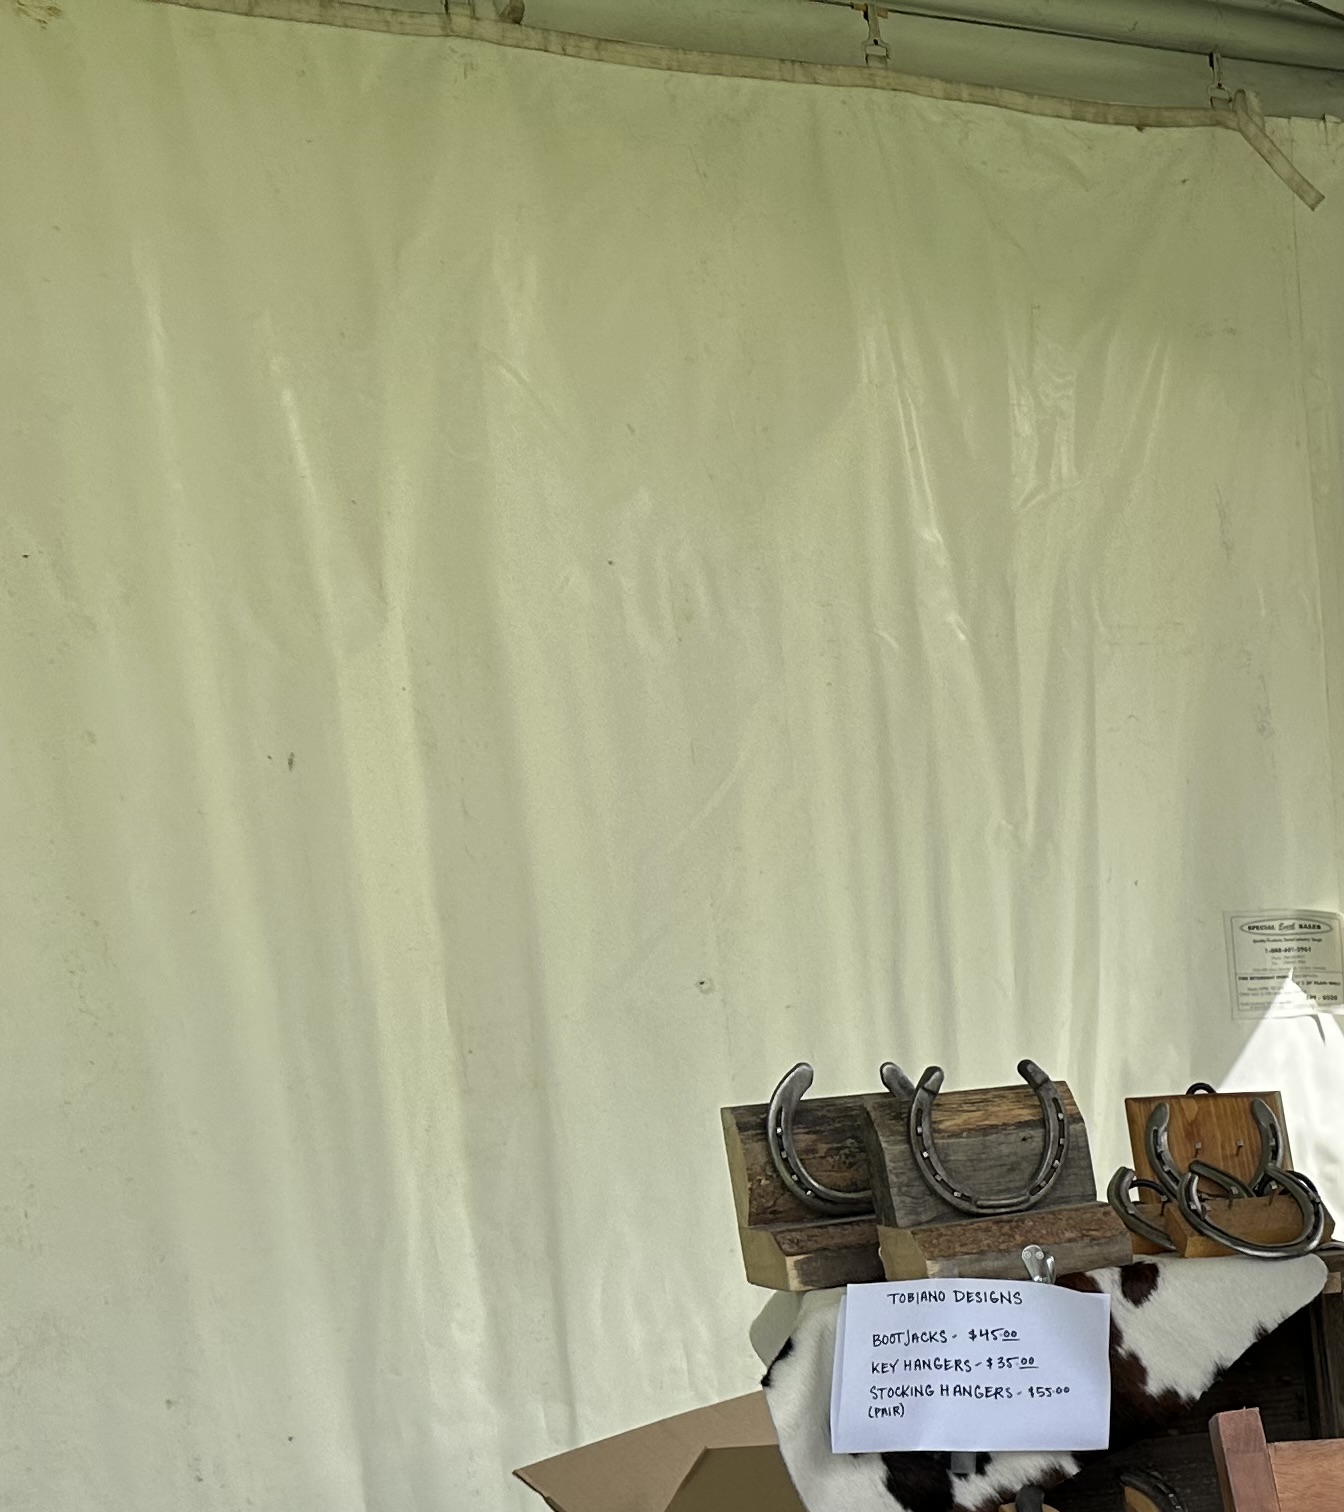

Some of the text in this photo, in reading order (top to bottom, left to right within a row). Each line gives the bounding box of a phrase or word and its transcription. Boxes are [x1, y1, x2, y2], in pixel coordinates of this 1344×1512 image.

[887, 1289, 1023, 1305] TOBIANO DESIGNS
[871, 1358, 900, 1375] KEY
[903, 1358, 973, 1373] HANGERS
[869, 1384, 935, 1400] STOCKING
[940, 1384, 1013, 1400] HANGERS
[1027, 1385, 1071, 1399] $55.00
[868, 1402, 905, 1419] (PAIR)
